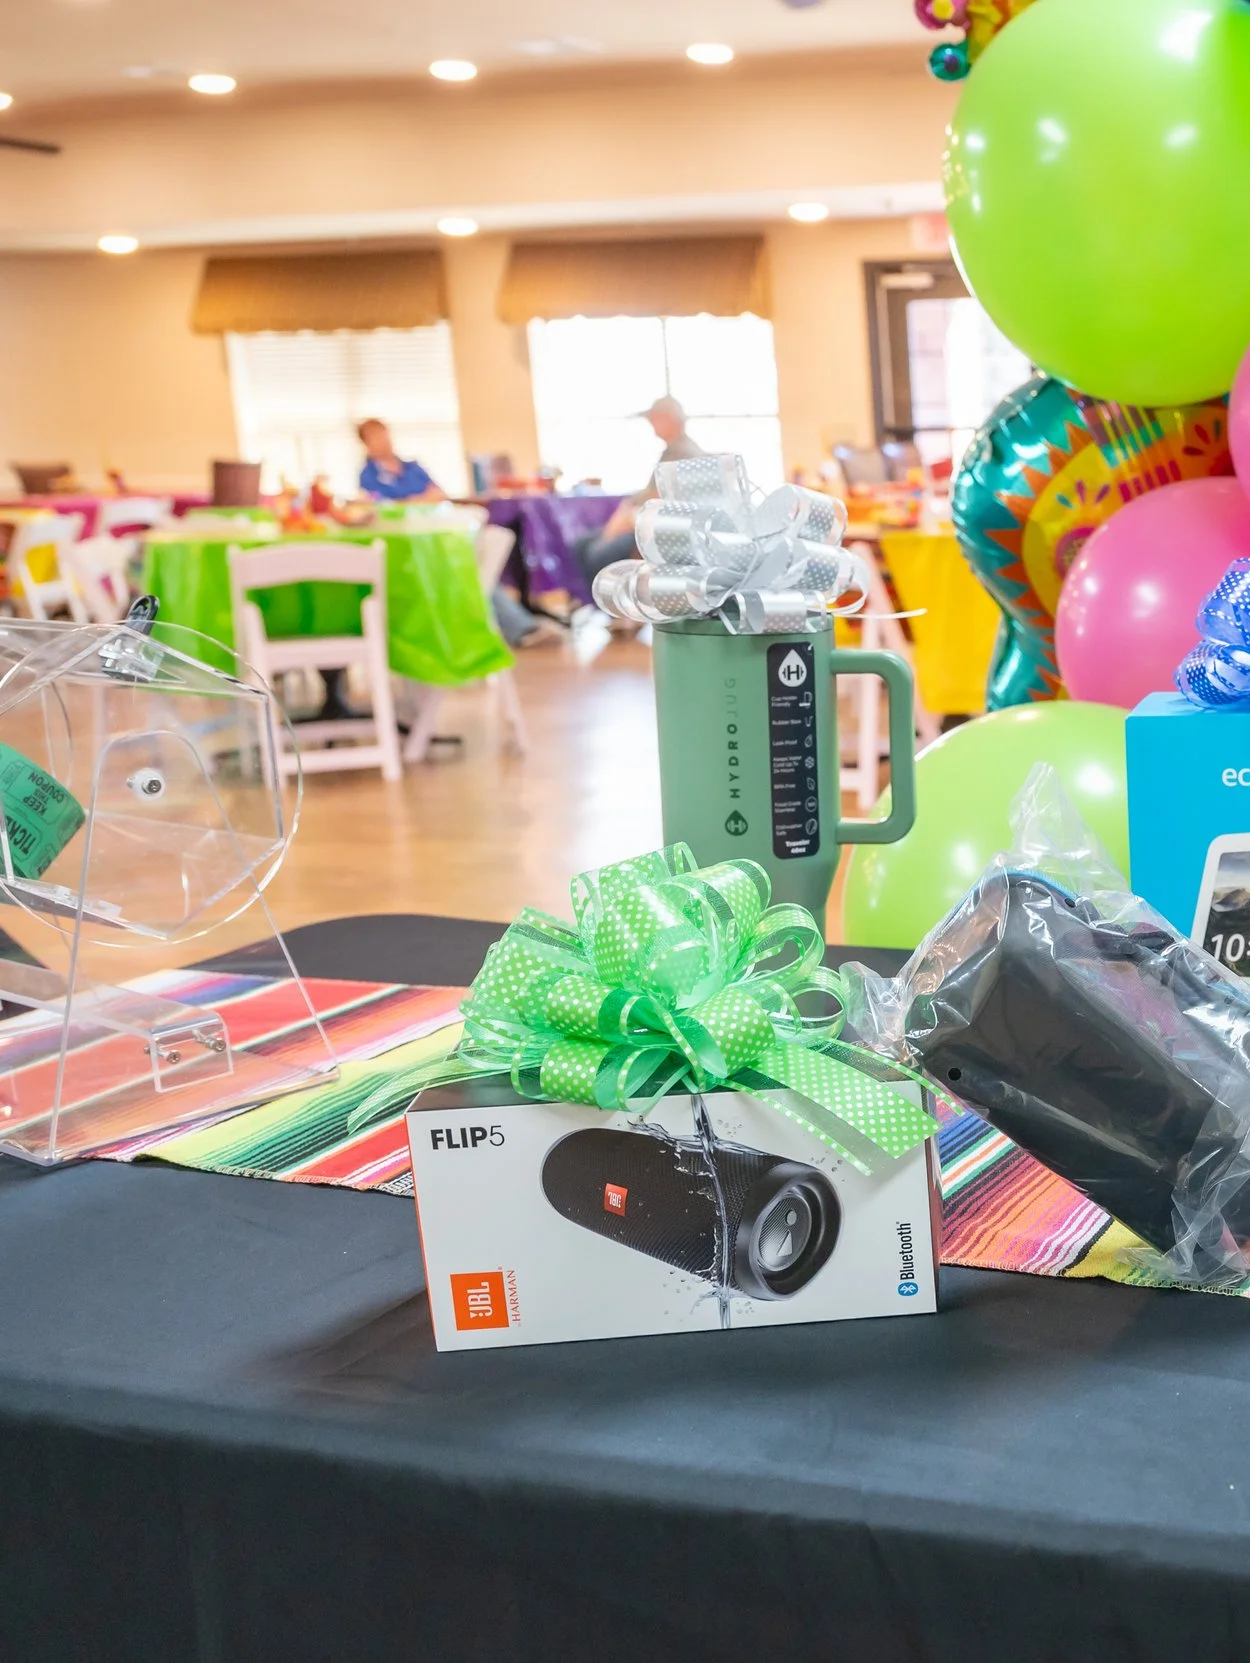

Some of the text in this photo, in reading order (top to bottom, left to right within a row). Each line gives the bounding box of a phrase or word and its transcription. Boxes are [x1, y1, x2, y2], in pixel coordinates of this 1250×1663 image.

[23, 796, 49, 817] KEEP
[28, 771, 65, 805] COUPON
[897, 1222, 915, 1280] Bluetooth
[468, 1281, 493, 1319] JBL
[507, 1269, 521, 1322] HARMAN
